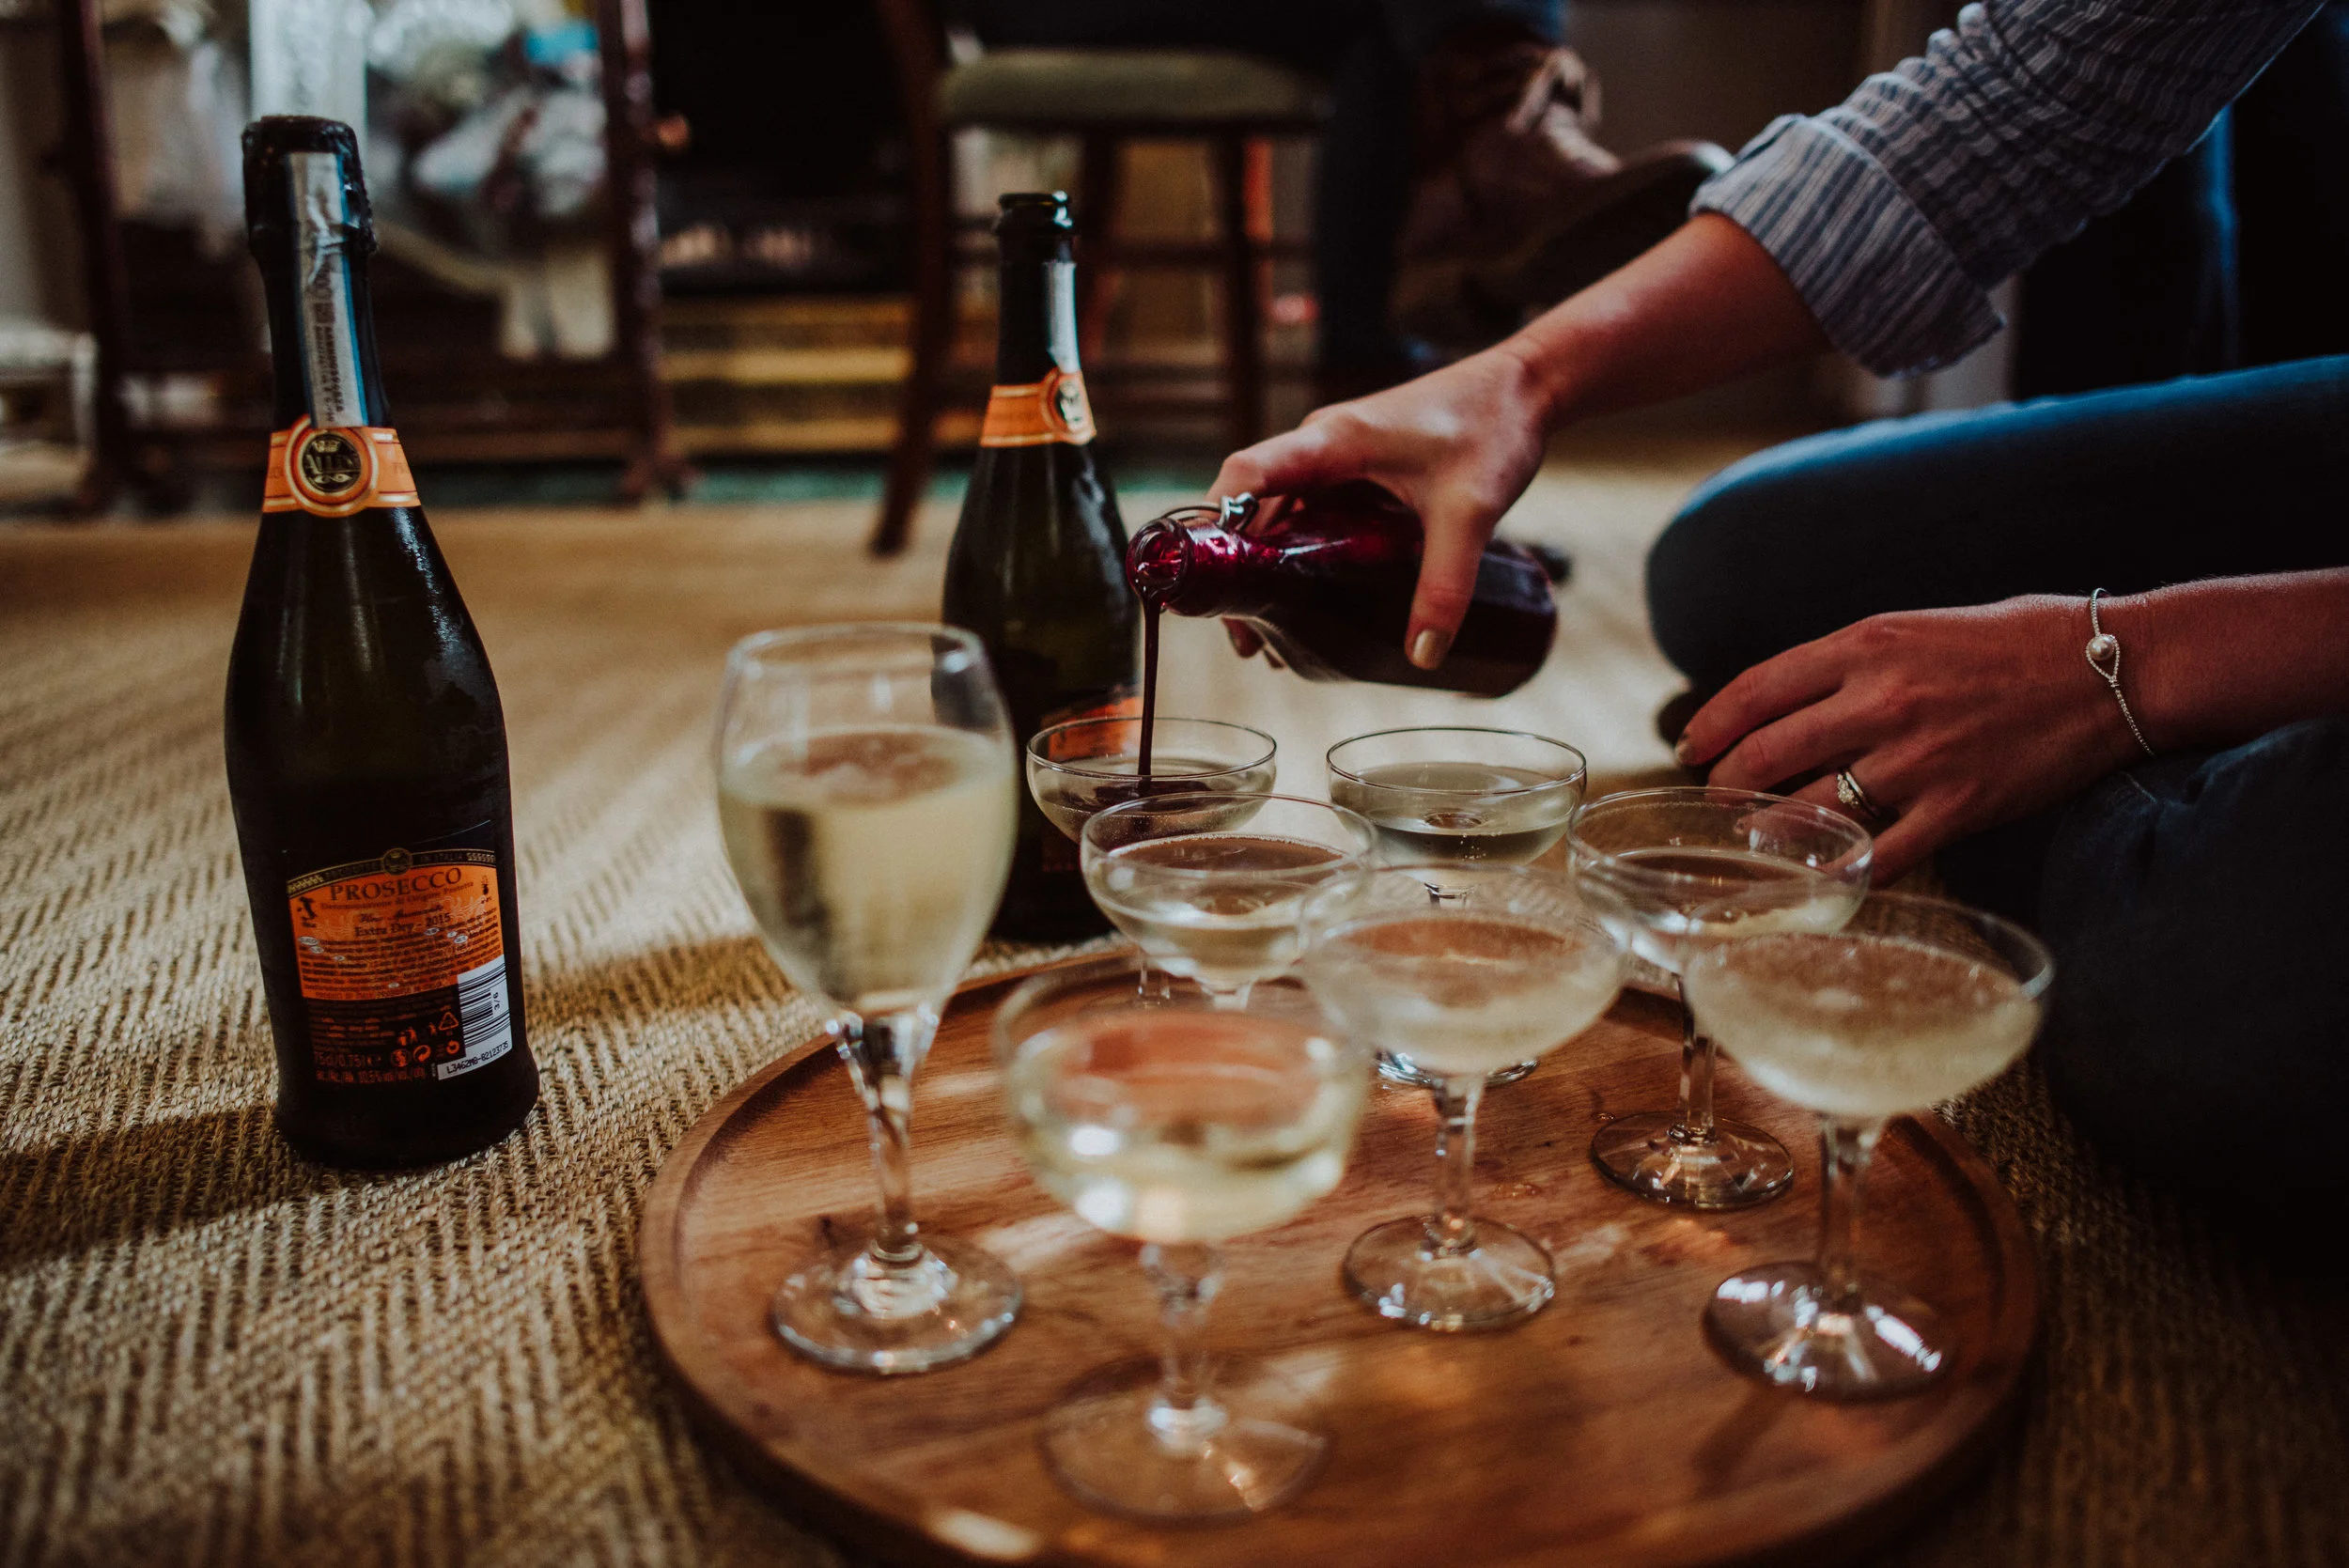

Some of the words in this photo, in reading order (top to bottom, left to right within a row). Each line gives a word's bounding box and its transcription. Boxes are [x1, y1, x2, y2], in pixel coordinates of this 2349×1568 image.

[330, 867, 462, 901] PROSECCO
[354, 926, 387, 937] Extra
[391, 921, 414, 934] Dry
[426, 912, 451, 927] 2015
